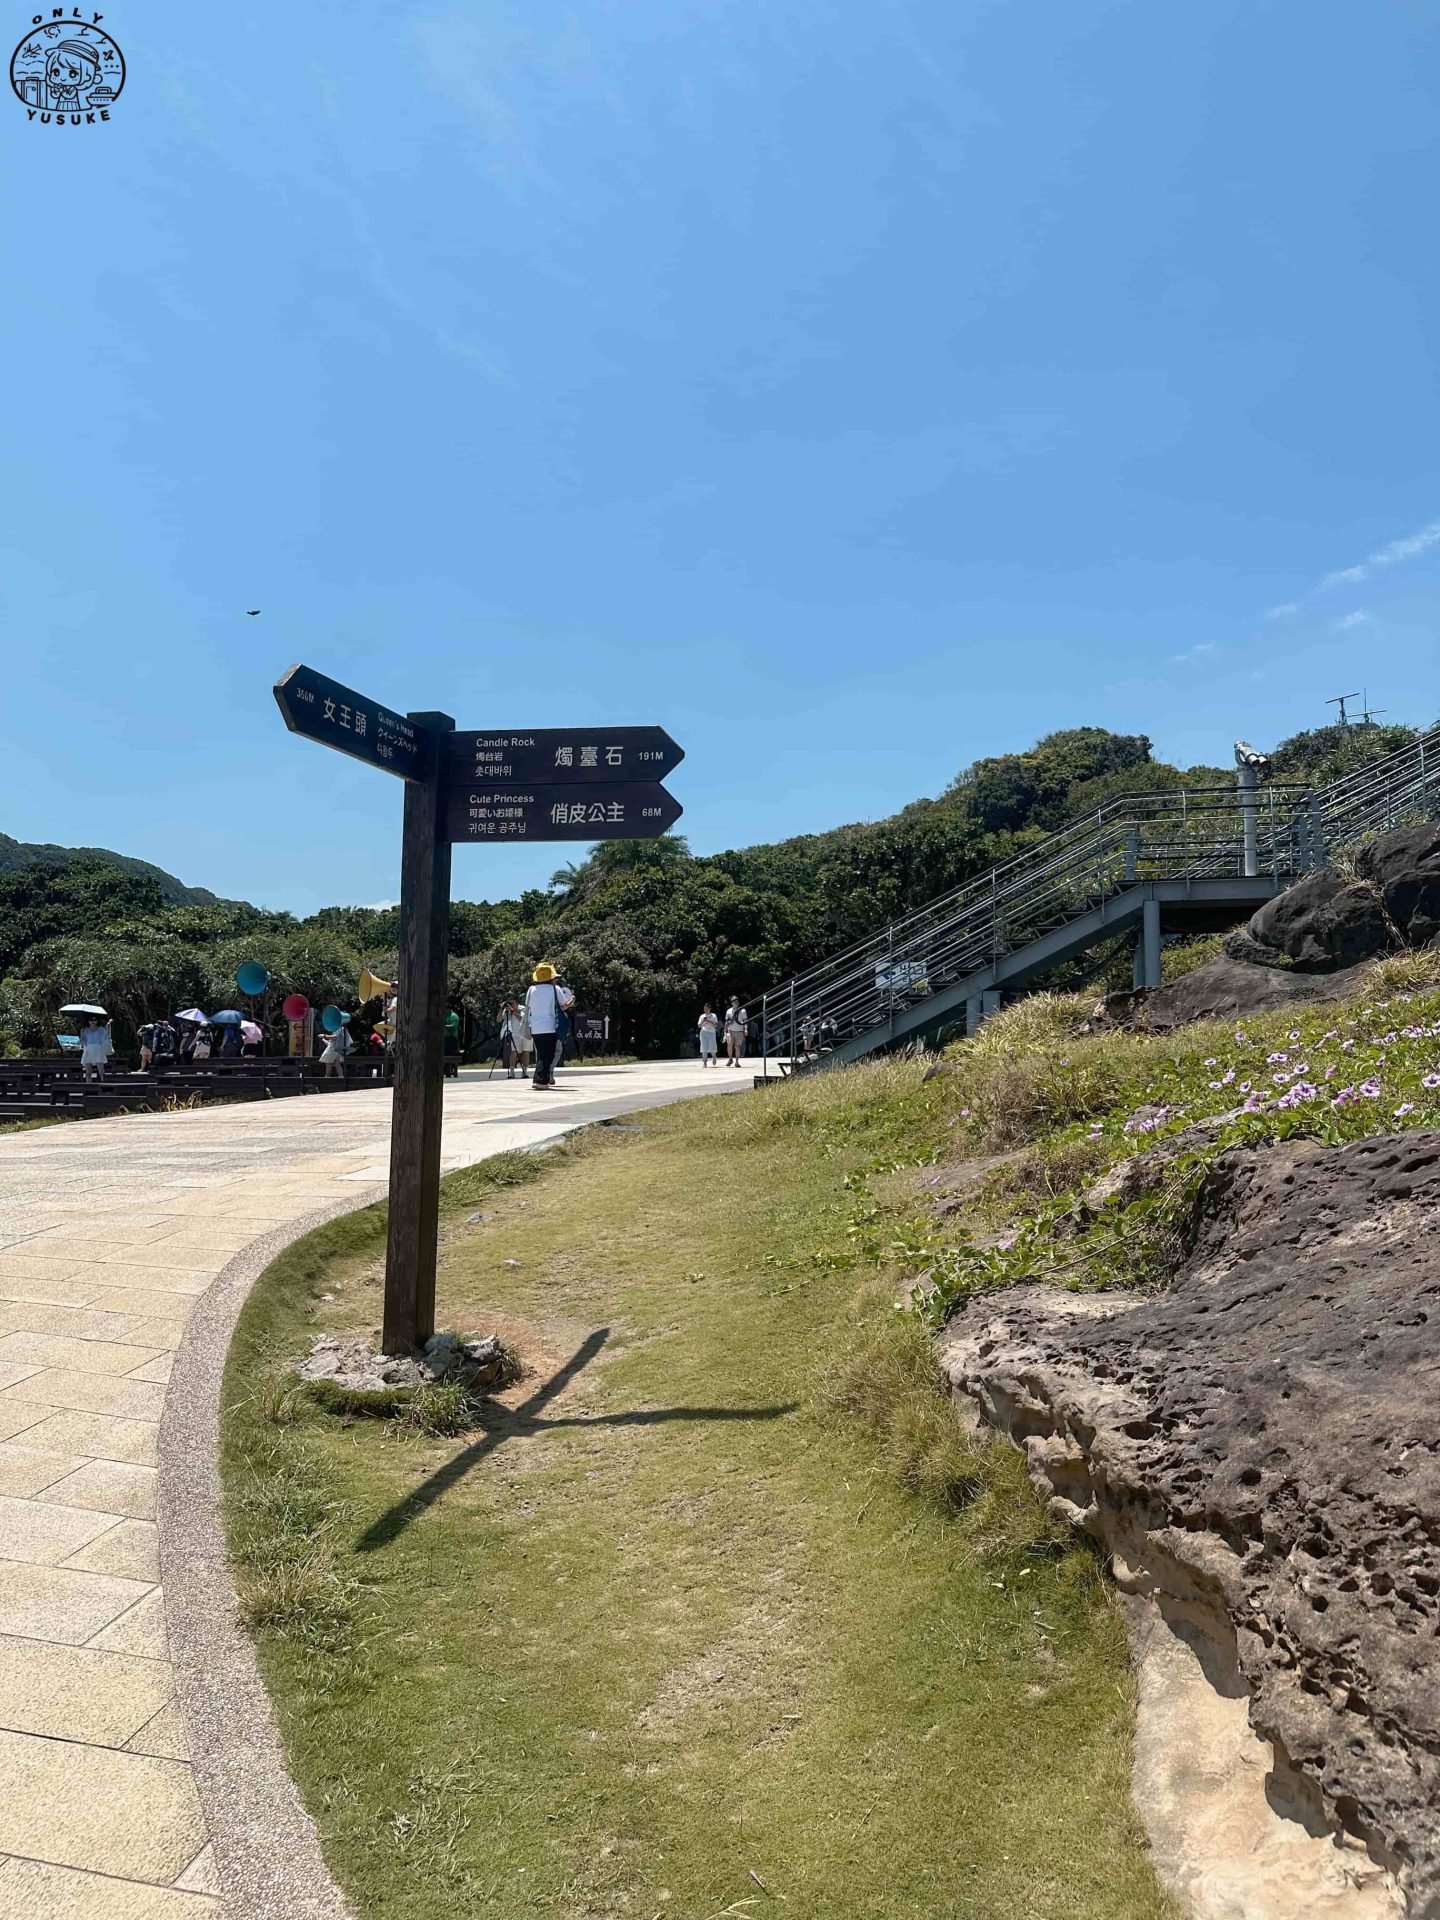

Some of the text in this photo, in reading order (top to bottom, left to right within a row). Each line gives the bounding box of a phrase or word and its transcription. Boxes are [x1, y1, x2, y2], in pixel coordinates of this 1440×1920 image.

[323, 697, 367, 736] 女王頭
[400, 723, 414, 737] Head
[476, 737, 535, 747] Candle Rock
[639, 751, 663, 760] 191M
[469, 794, 534, 803] Cute Princess
[469, 808, 523, 818] 可愛いお姫様
[550, 802, 624, 824] 俏皮公主
[642, 807, 661, 816] 68M
[468, 822, 526, 834] 귀여운 공주님
